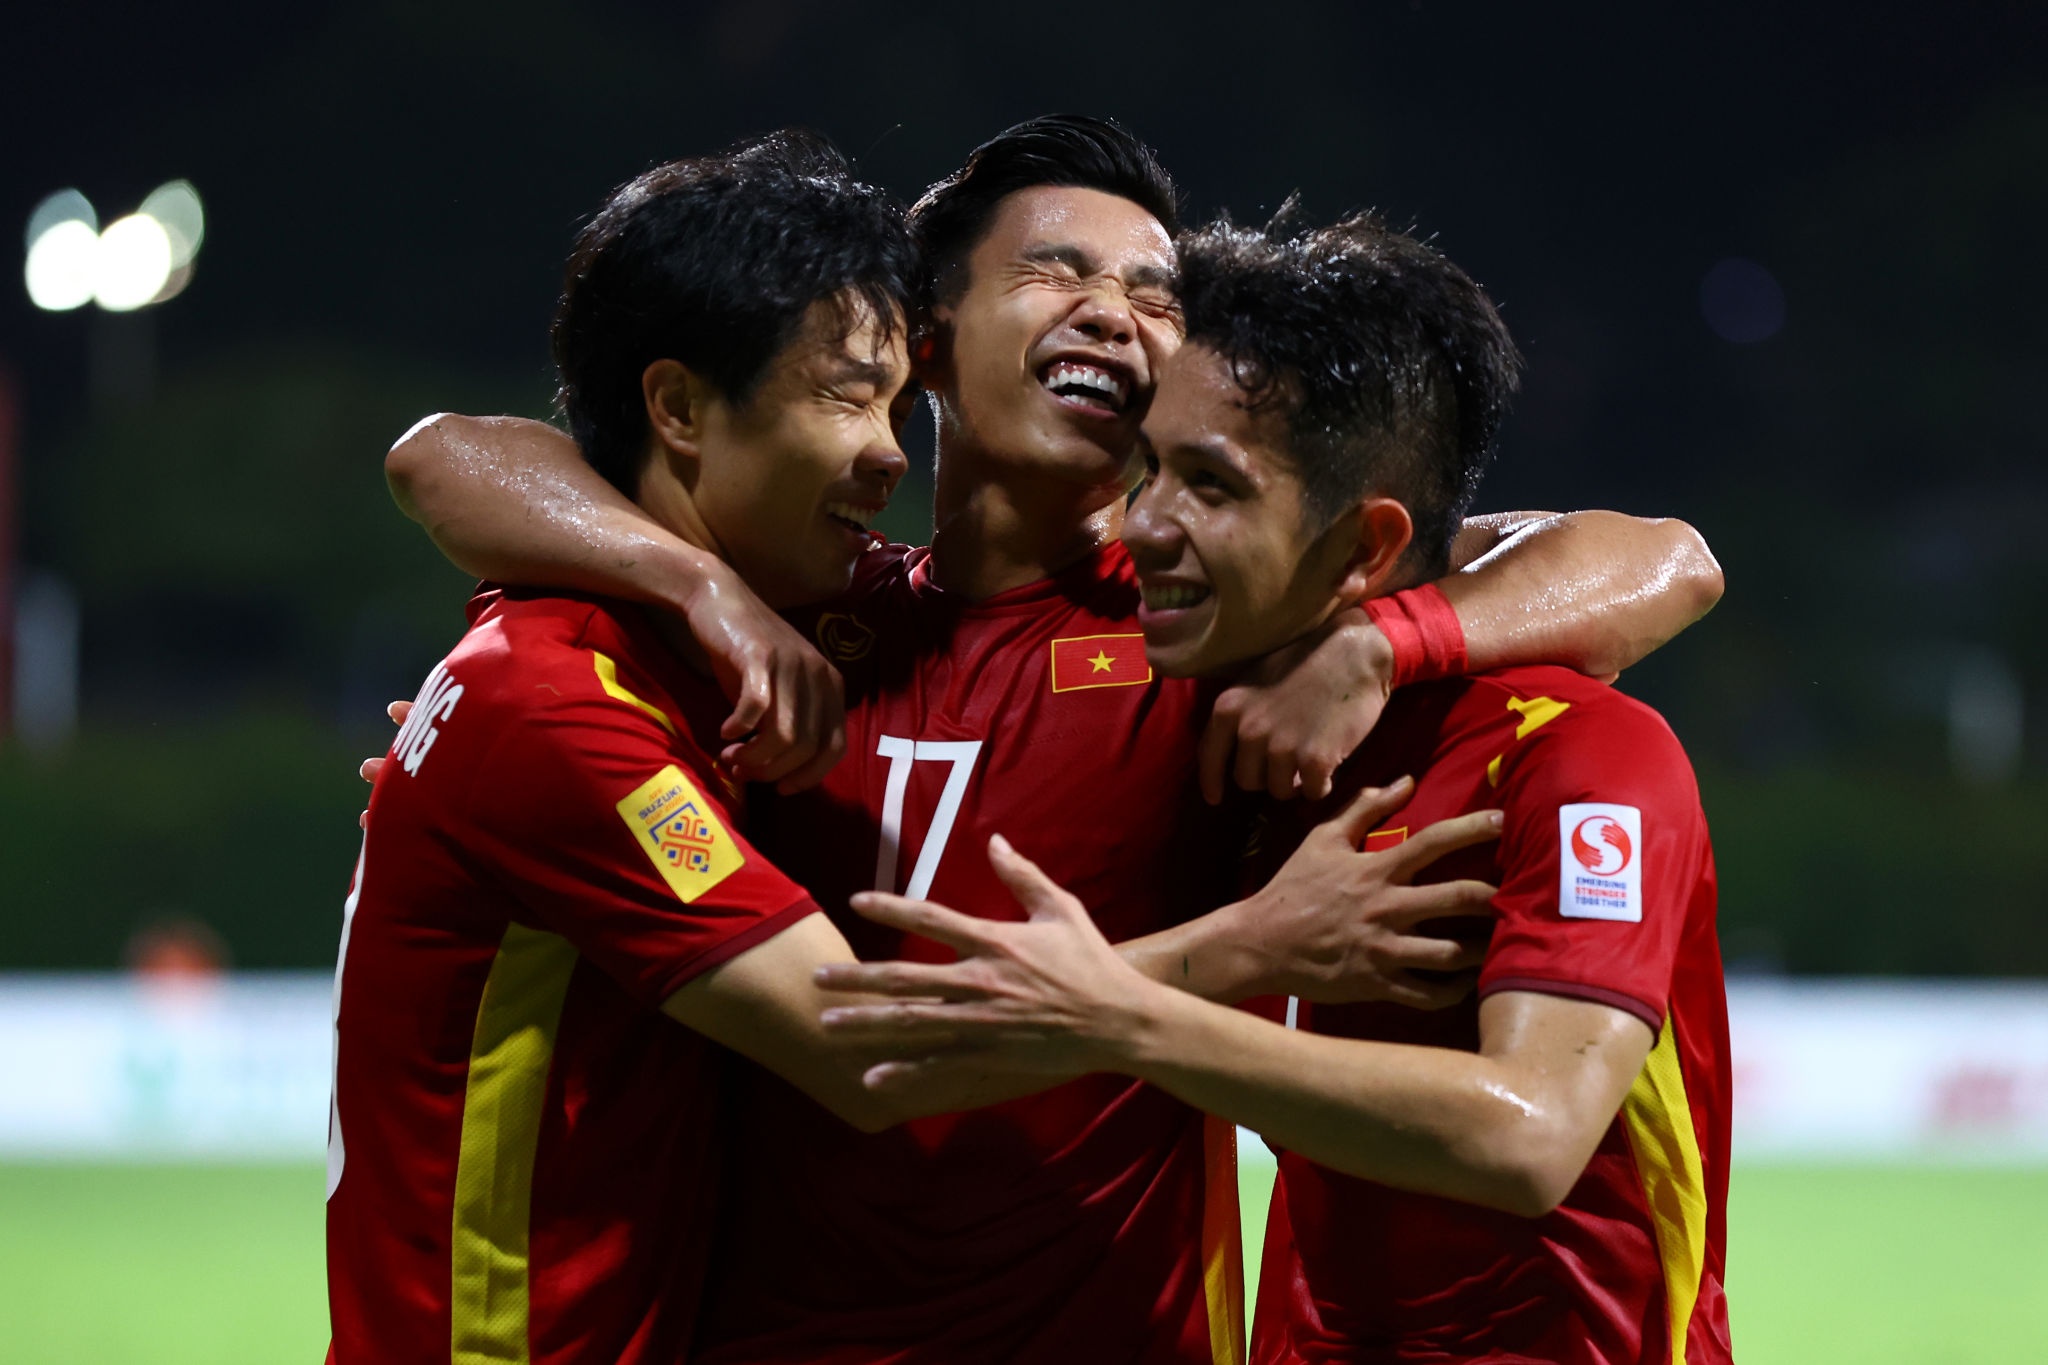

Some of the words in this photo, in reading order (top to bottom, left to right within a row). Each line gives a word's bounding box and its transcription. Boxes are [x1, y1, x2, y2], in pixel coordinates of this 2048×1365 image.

[638, 785, 682, 819] SUZUKI
[874, 734, 983, 901] 17
[1575, 876, 1627, 889] EMERGING
[1575, 886, 1627, 899] STRONGER
[1575, 896, 1627, 908] TOGETHER
